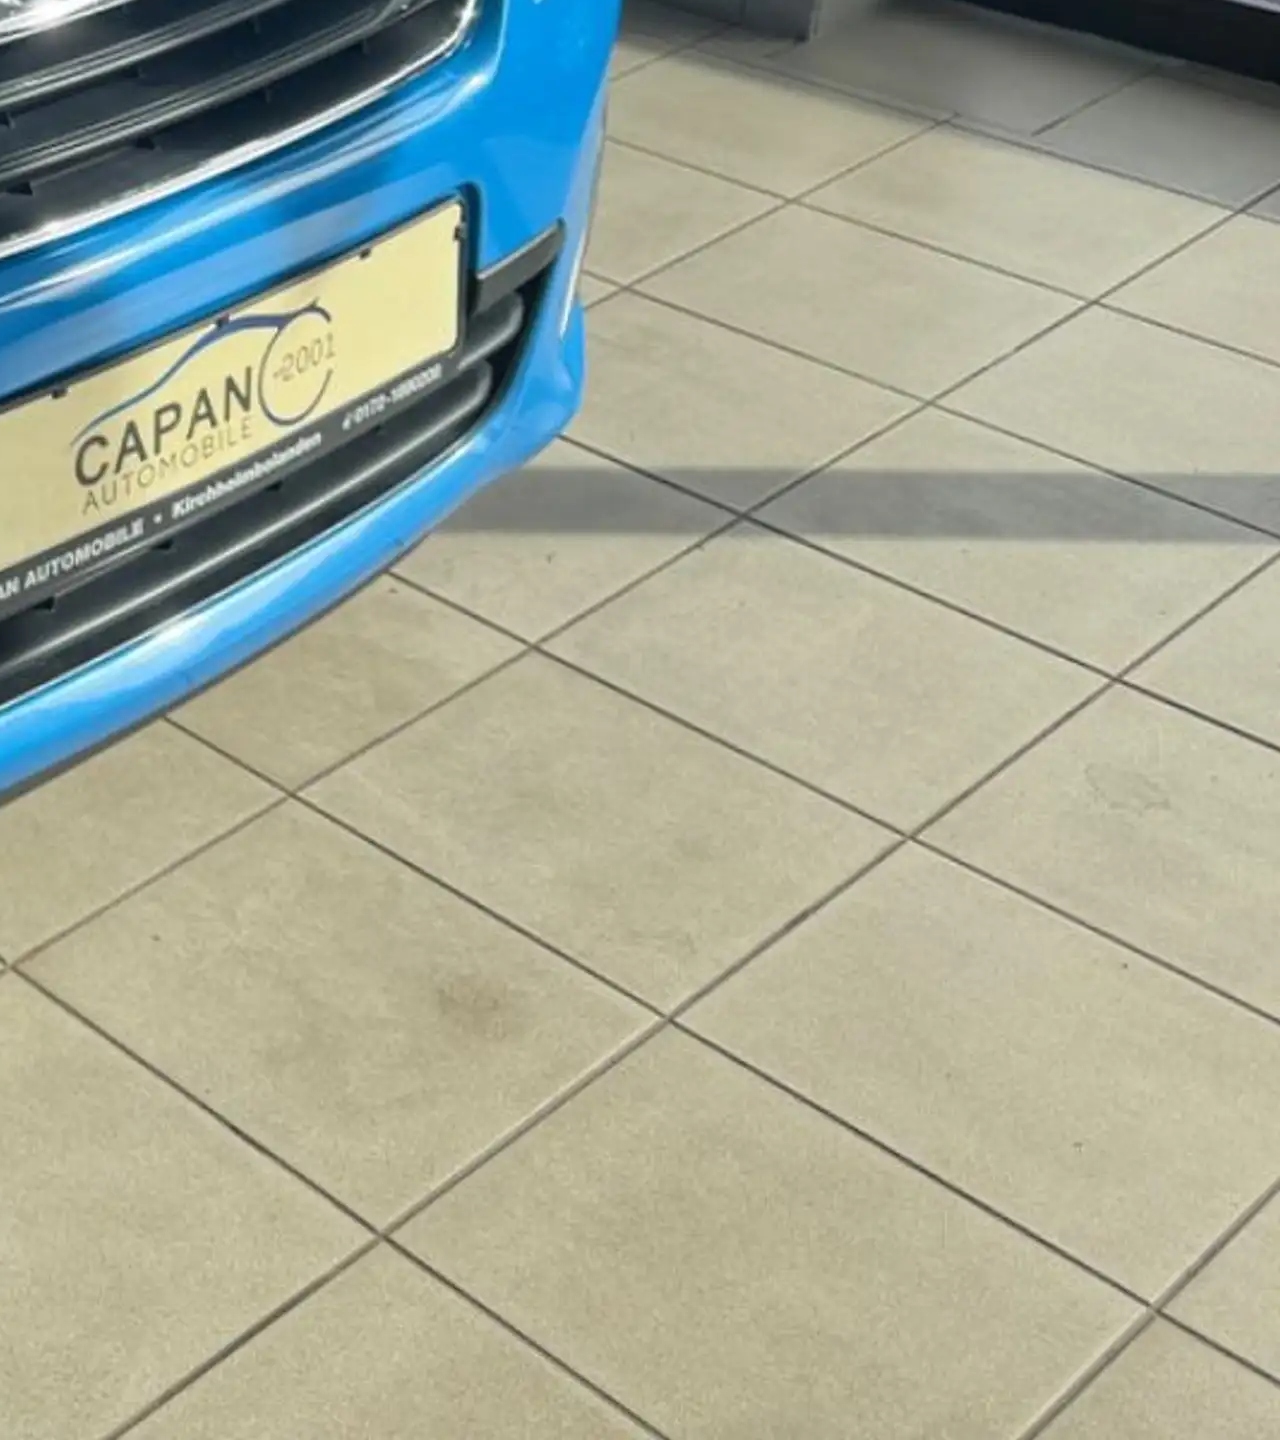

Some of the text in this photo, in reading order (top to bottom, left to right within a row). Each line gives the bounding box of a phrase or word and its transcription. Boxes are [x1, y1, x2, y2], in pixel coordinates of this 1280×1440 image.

[74, 365, 253, 487] CAPAN
[83, 415, 254, 516] AUTOMOBILE
[24, 517, 144, 590] AUTOMOBILE
